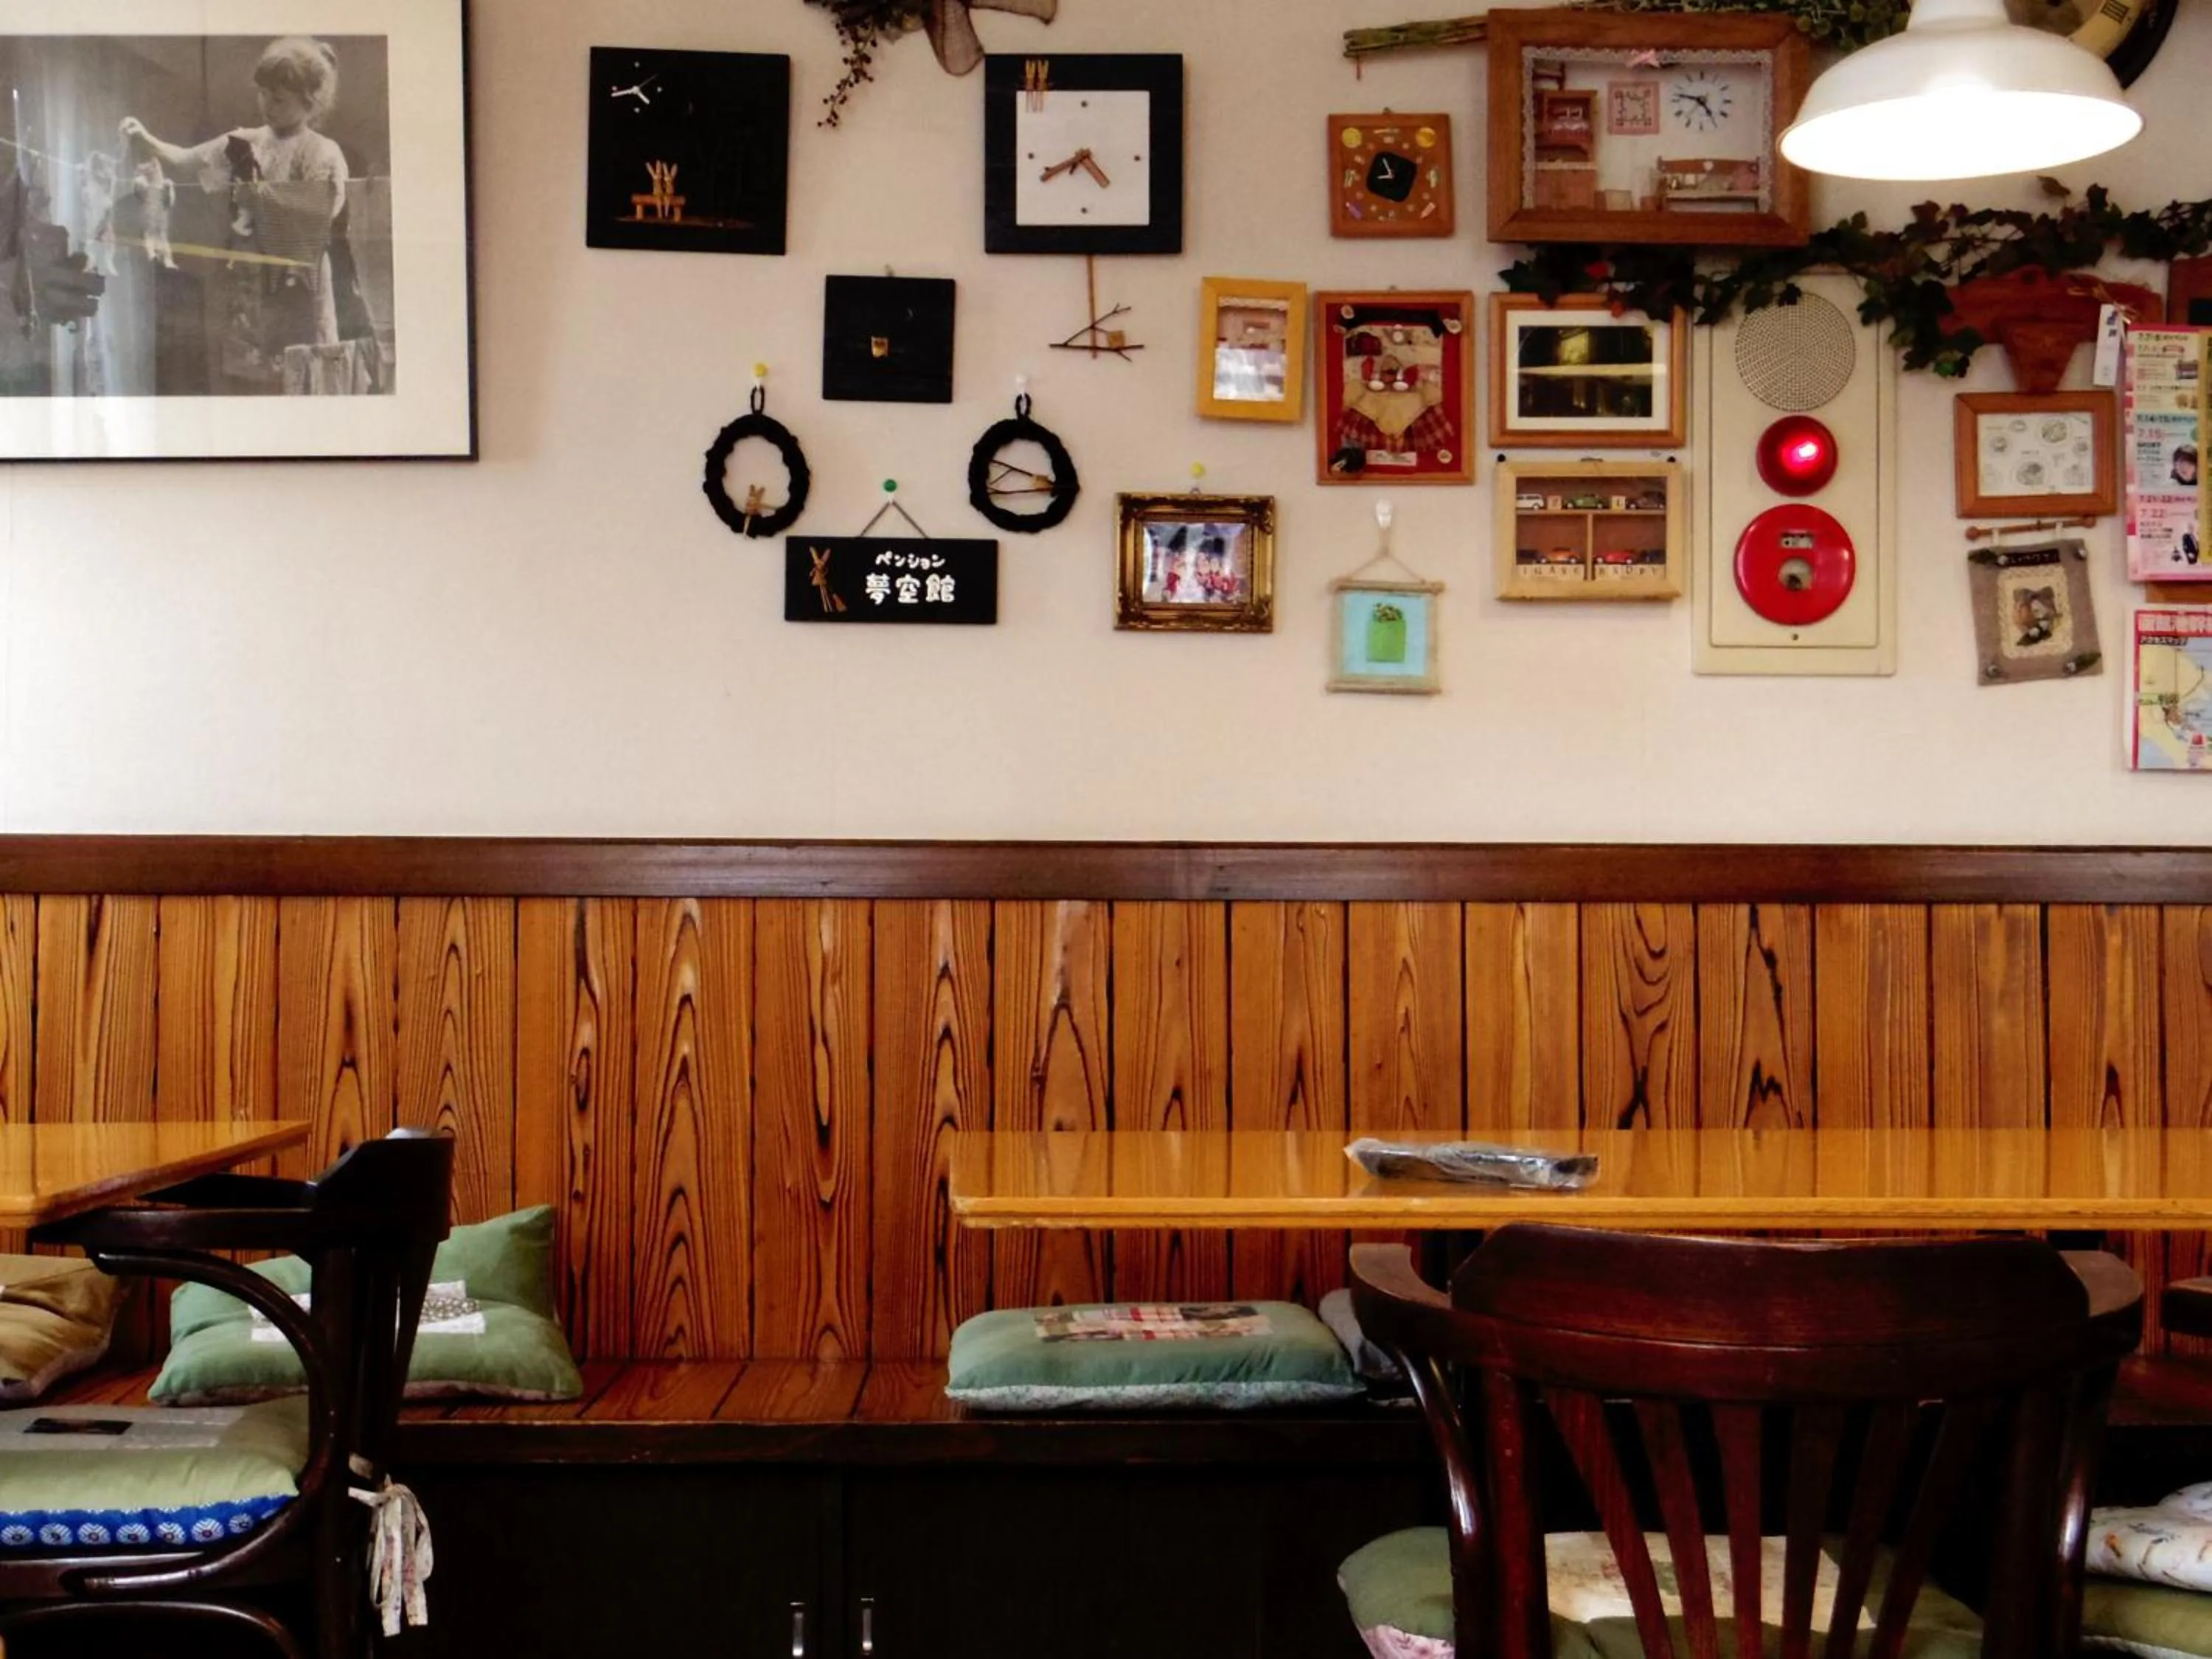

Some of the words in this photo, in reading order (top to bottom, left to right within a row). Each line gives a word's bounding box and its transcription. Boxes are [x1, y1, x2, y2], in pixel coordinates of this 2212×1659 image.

[875, 551, 946, 570] ペンション
[865, 573, 956, 605] 夢空館
